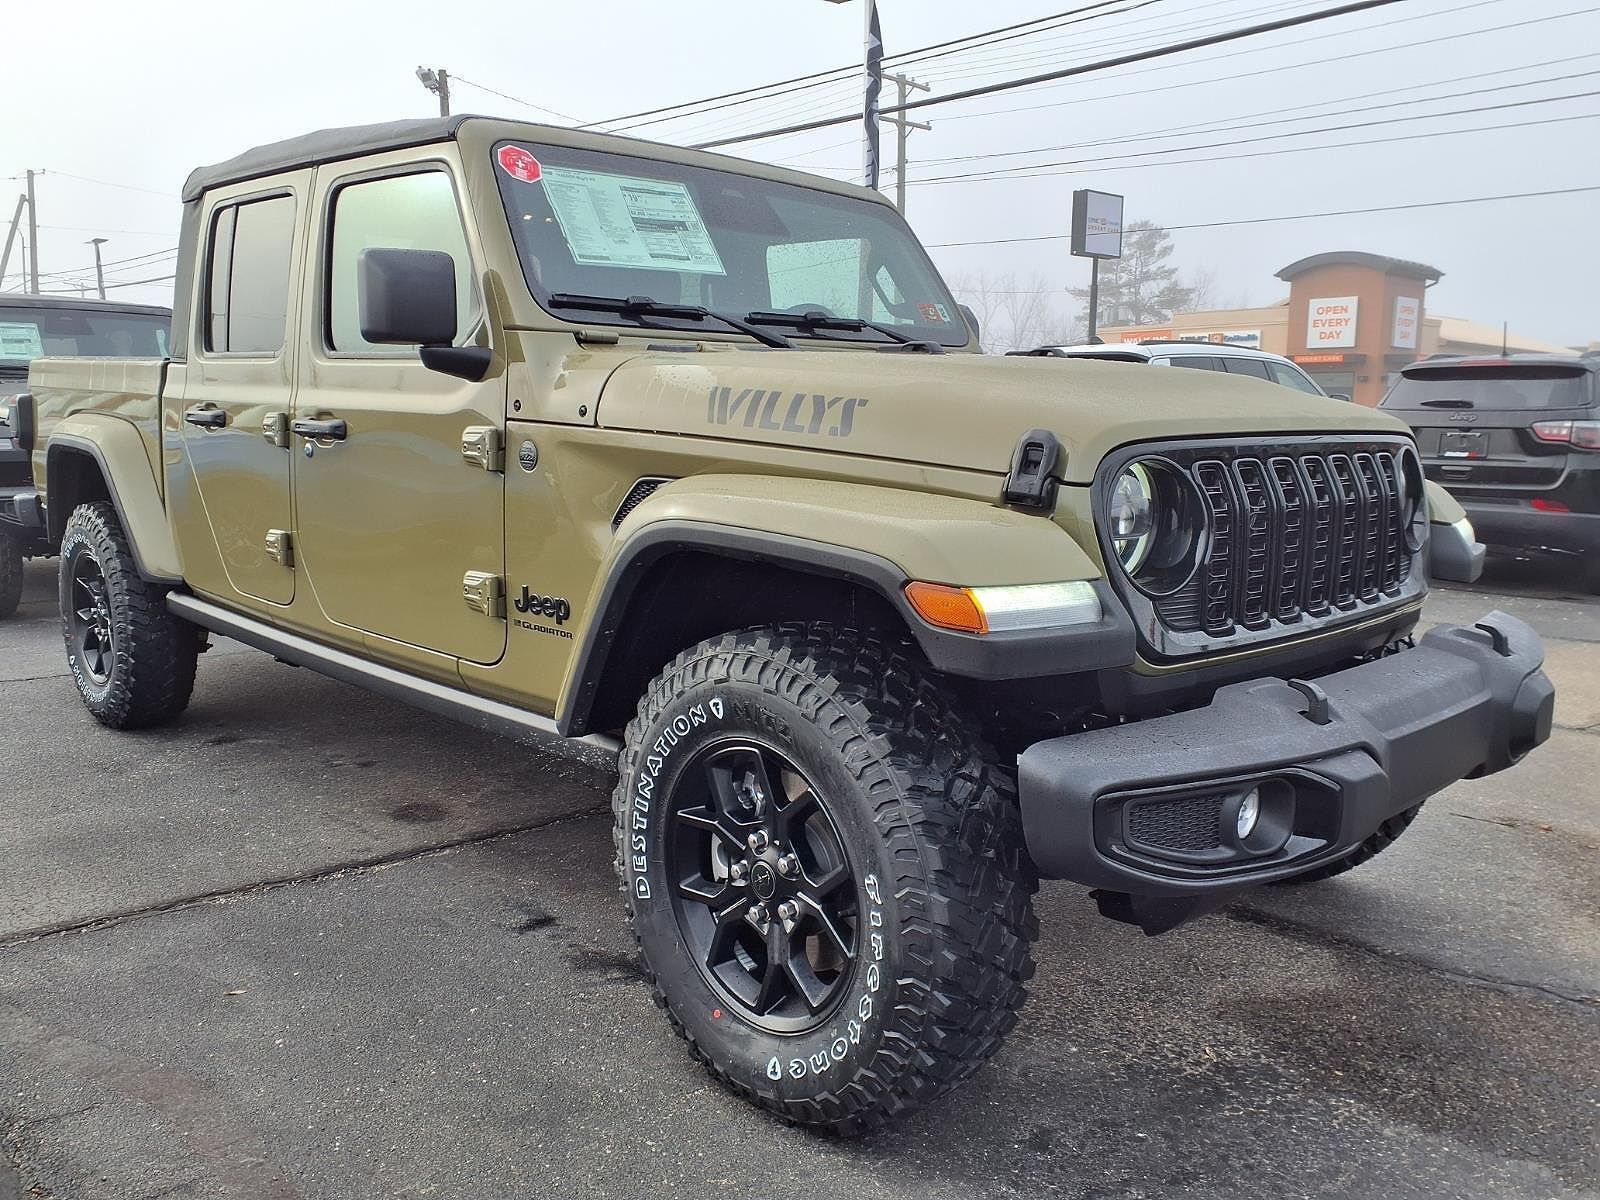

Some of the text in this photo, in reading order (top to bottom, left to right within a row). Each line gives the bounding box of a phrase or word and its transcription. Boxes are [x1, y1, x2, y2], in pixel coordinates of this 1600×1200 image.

[1312, 317, 1351, 328] EVERY
[1316, 305, 1349, 316] OPEN
[1319, 330, 1343, 340] DAY
[707, 385, 869, 437] WILLYS
[514, 585, 570, 625] Jeep
[522, 621, 573, 640] GLADIATOR
[635, 702, 709, 899] DESTINATION
[788, 873, 885, 1081] Firestone
